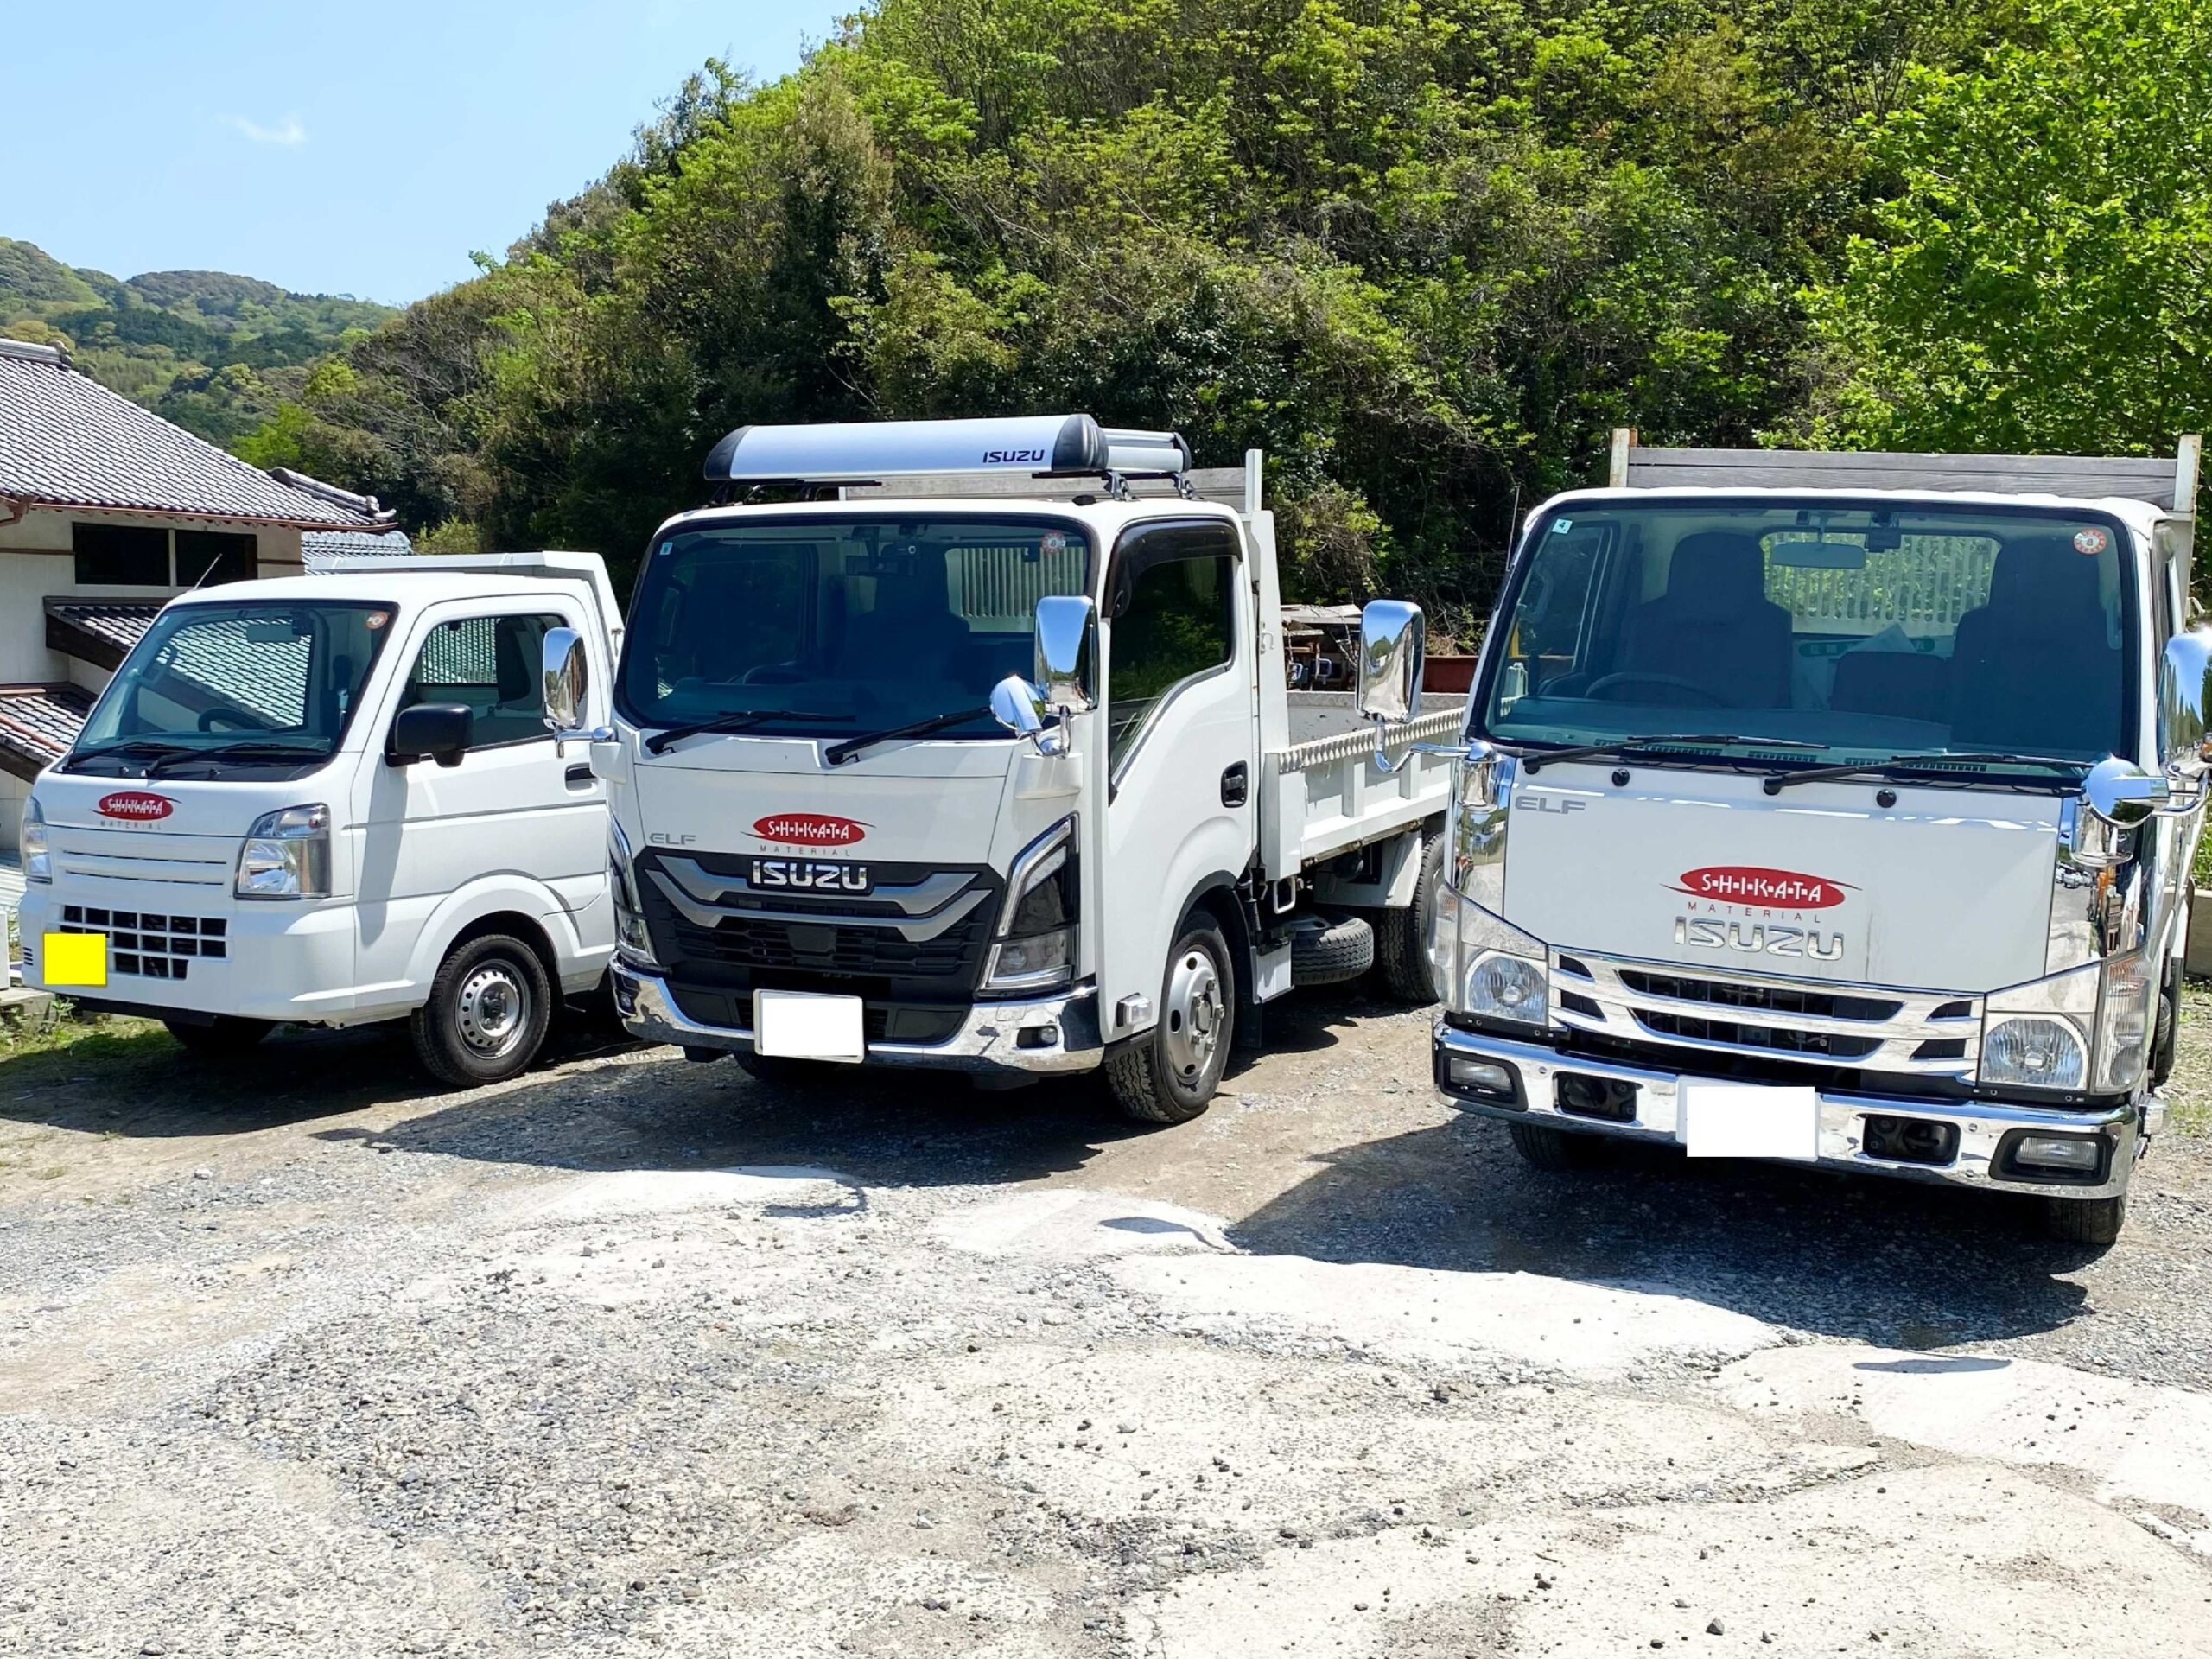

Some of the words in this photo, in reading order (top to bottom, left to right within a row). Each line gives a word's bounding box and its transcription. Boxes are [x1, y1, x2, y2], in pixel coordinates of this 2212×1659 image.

[982, 449, 1045, 463] ISUZU
[1515, 796, 1586, 815] ELF
[649, 832, 696, 845] ELF
[760, 844, 851, 857] MATERIAL
[753, 861, 867, 890] ISUZU
[1687, 901, 1822, 924] MATERIAL
[1674, 915, 1845, 962] ISUZU
